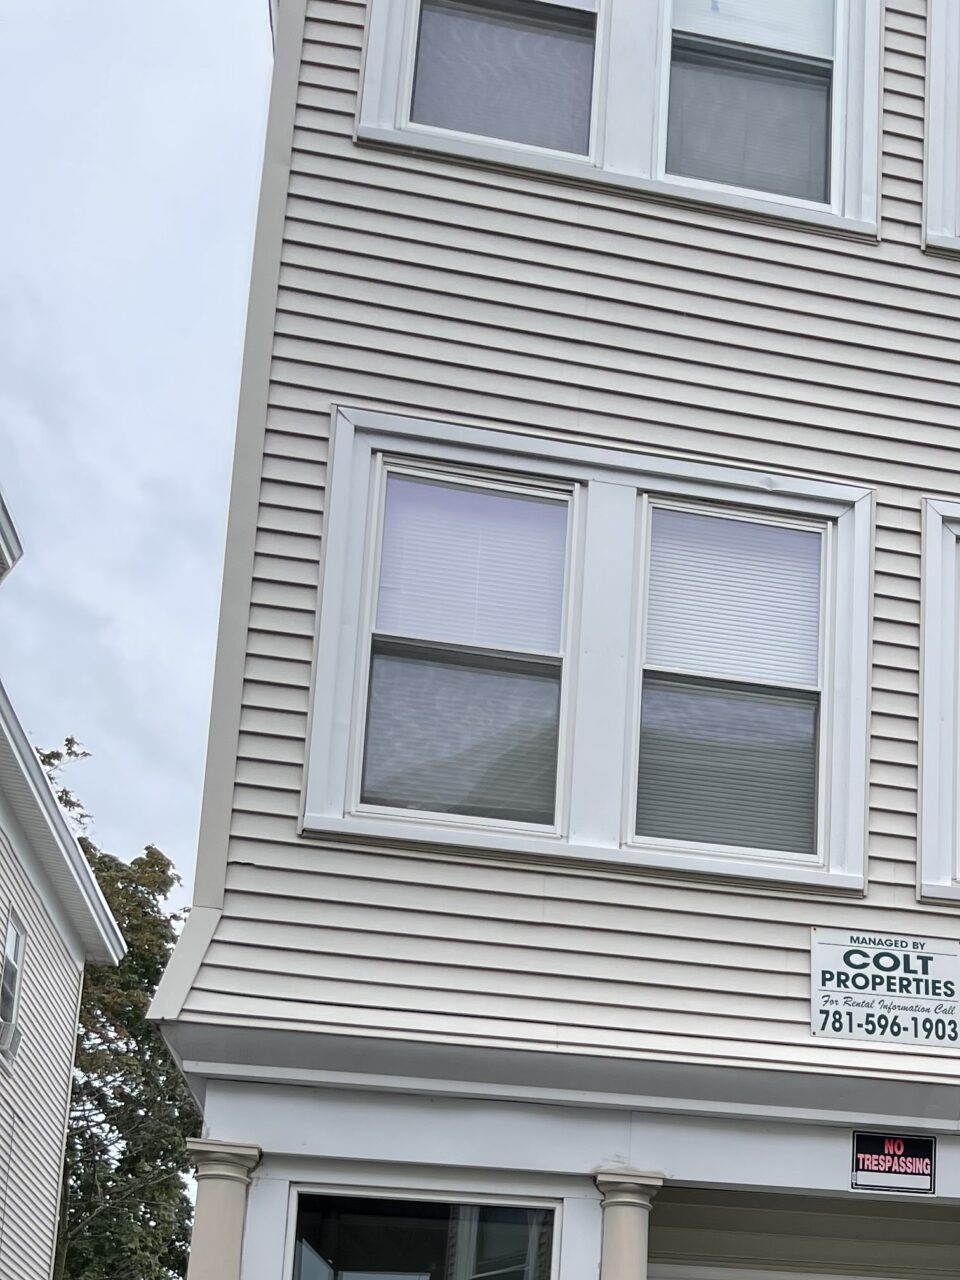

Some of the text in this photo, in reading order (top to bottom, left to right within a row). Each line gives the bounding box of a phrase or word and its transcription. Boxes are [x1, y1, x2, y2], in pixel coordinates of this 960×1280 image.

[850, 936, 926, 950] MANAGED BY
[843, 949, 933, 975] COLT
[821, 970, 955, 998] PROPERTIES
[821, 995, 956, 1015] For Rental Information Call
[819, 1009, 958, 1042] 781-596-1903
[884, 1138, 904, 1155] NO
[857, 1153, 931, 1174] TRESPASSING
